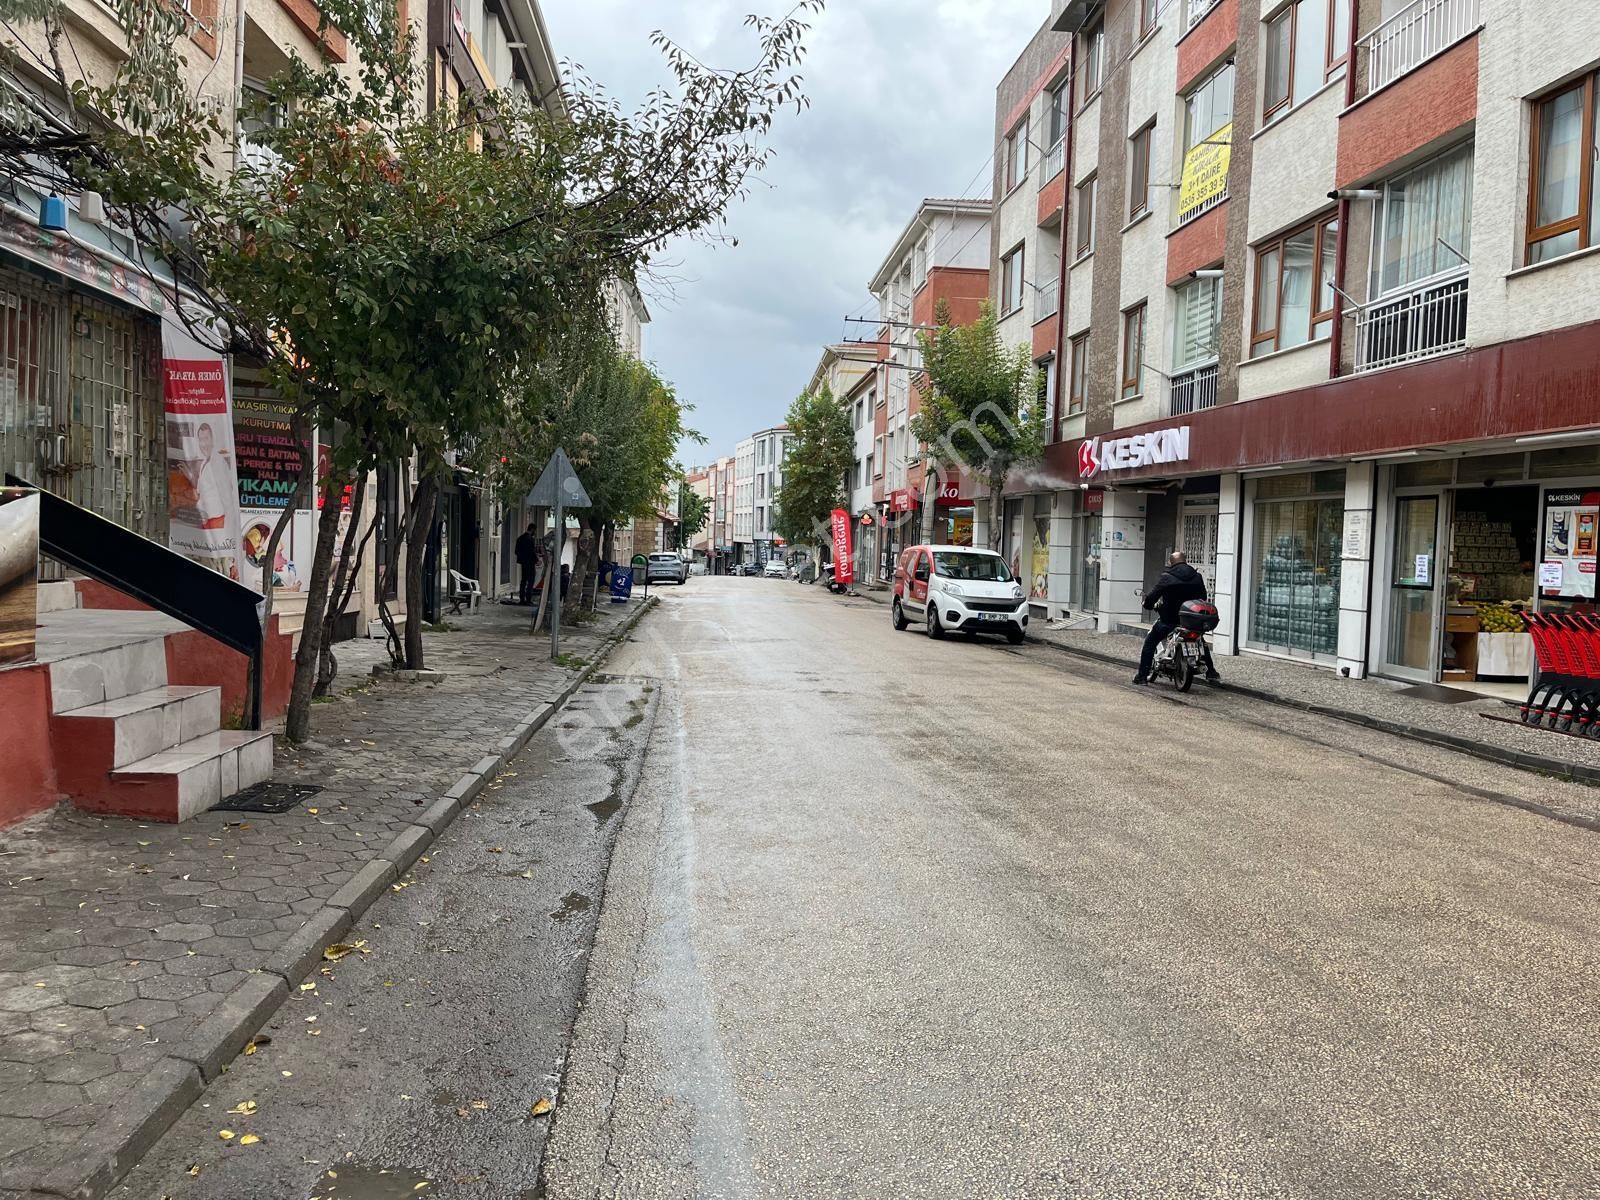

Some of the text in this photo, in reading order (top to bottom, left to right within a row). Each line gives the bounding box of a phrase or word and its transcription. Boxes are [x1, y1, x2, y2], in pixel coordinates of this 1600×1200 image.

[232, 401, 298, 414] AMAŞIR YIKA
[243, 418, 291, 430] KURUTMA
[235, 432, 312, 448] URU TEMİZLE
[236, 446, 257, 456] RGAN
[244, 459, 273, 469] PERDE
[258, 471, 279, 480] HALI
[241, 493, 289, 506] ÜTÜLEME
